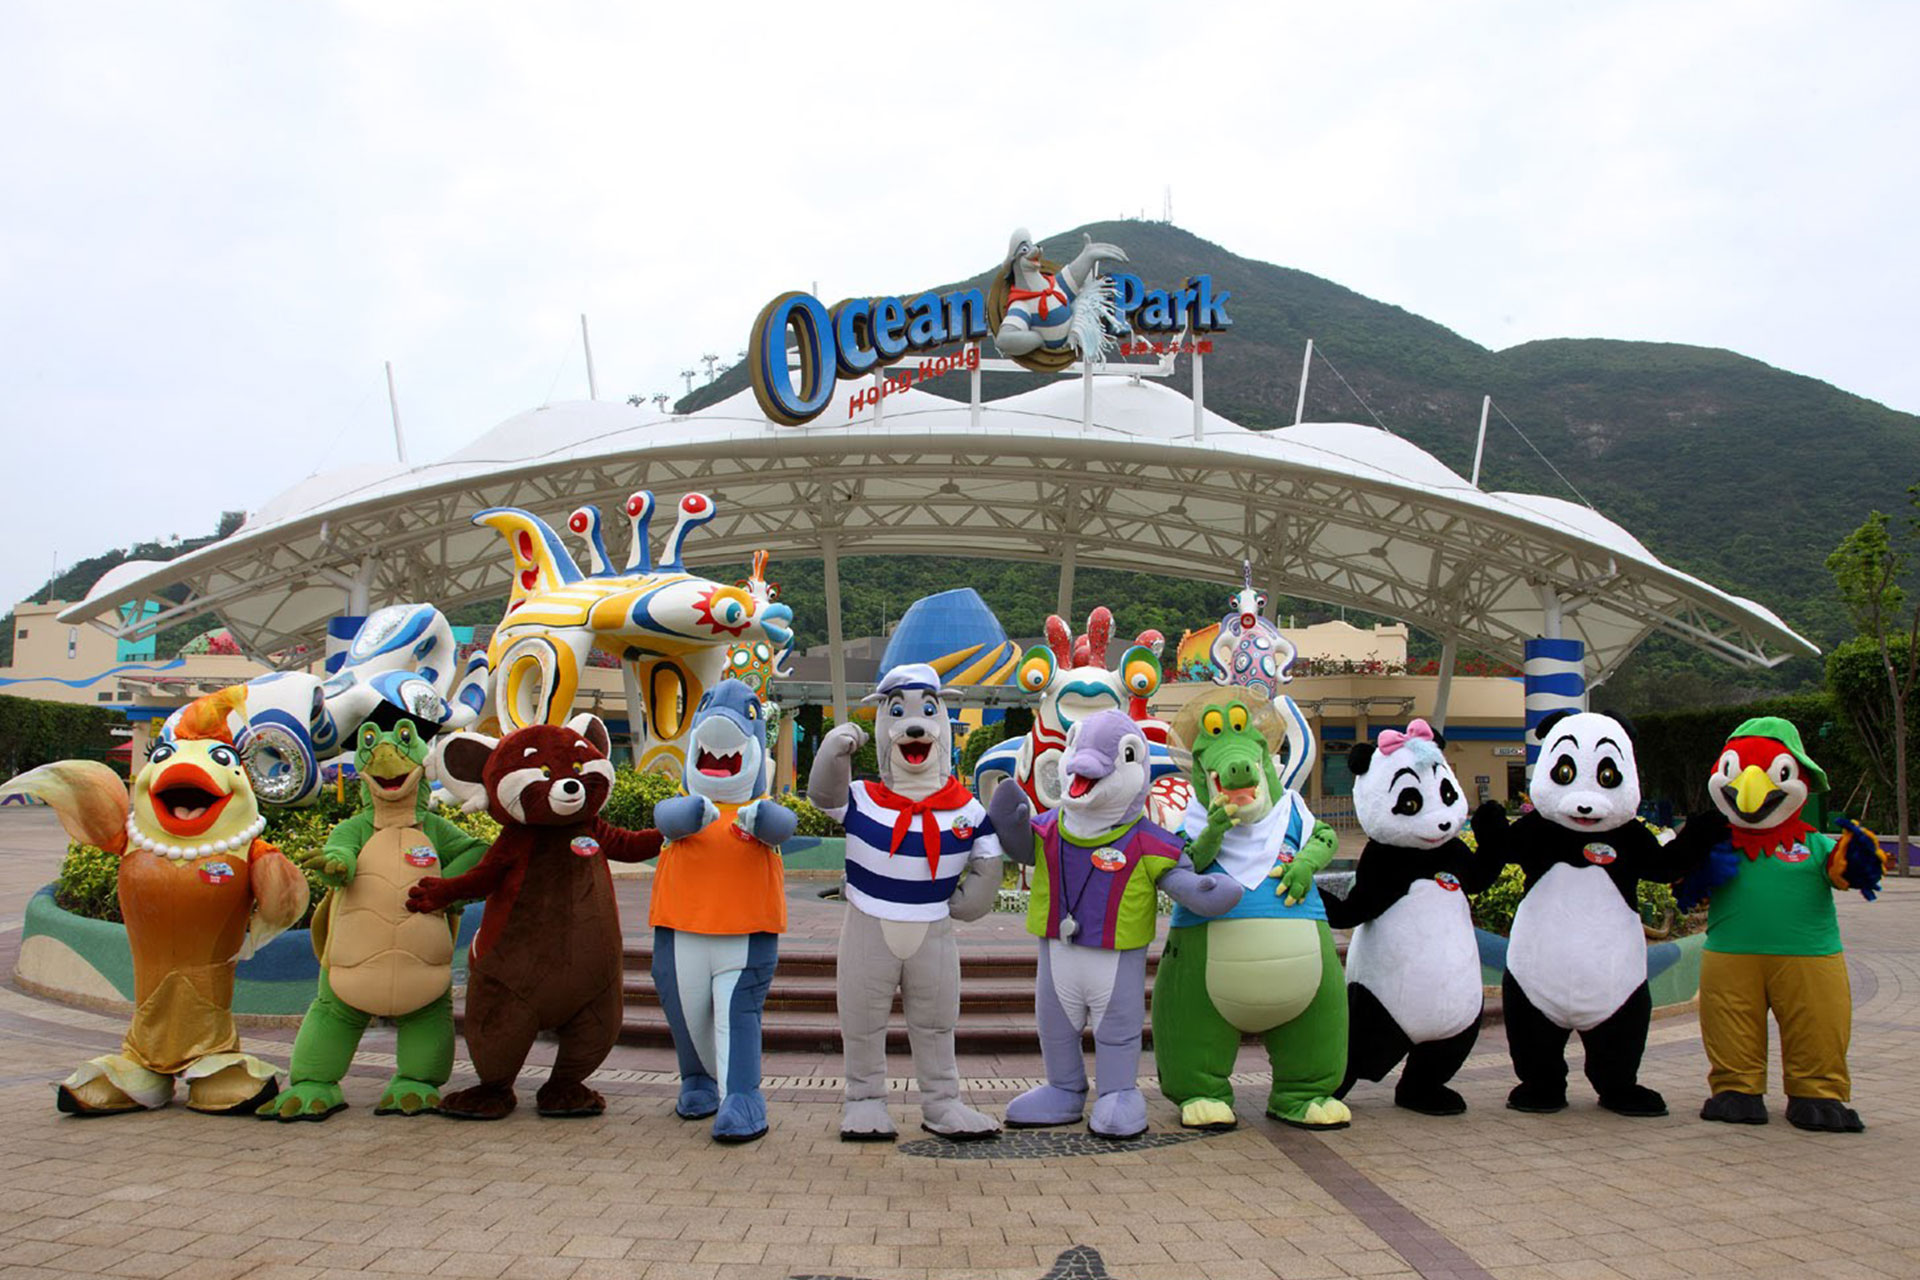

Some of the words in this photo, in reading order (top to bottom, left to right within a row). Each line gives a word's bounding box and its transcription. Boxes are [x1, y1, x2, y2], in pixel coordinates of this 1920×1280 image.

[751, 288, 989, 426] Ocean
[1110, 272, 1233, 335] Park
[849, 369, 912, 419] Hong
[918, 347, 980, 383] Kong
